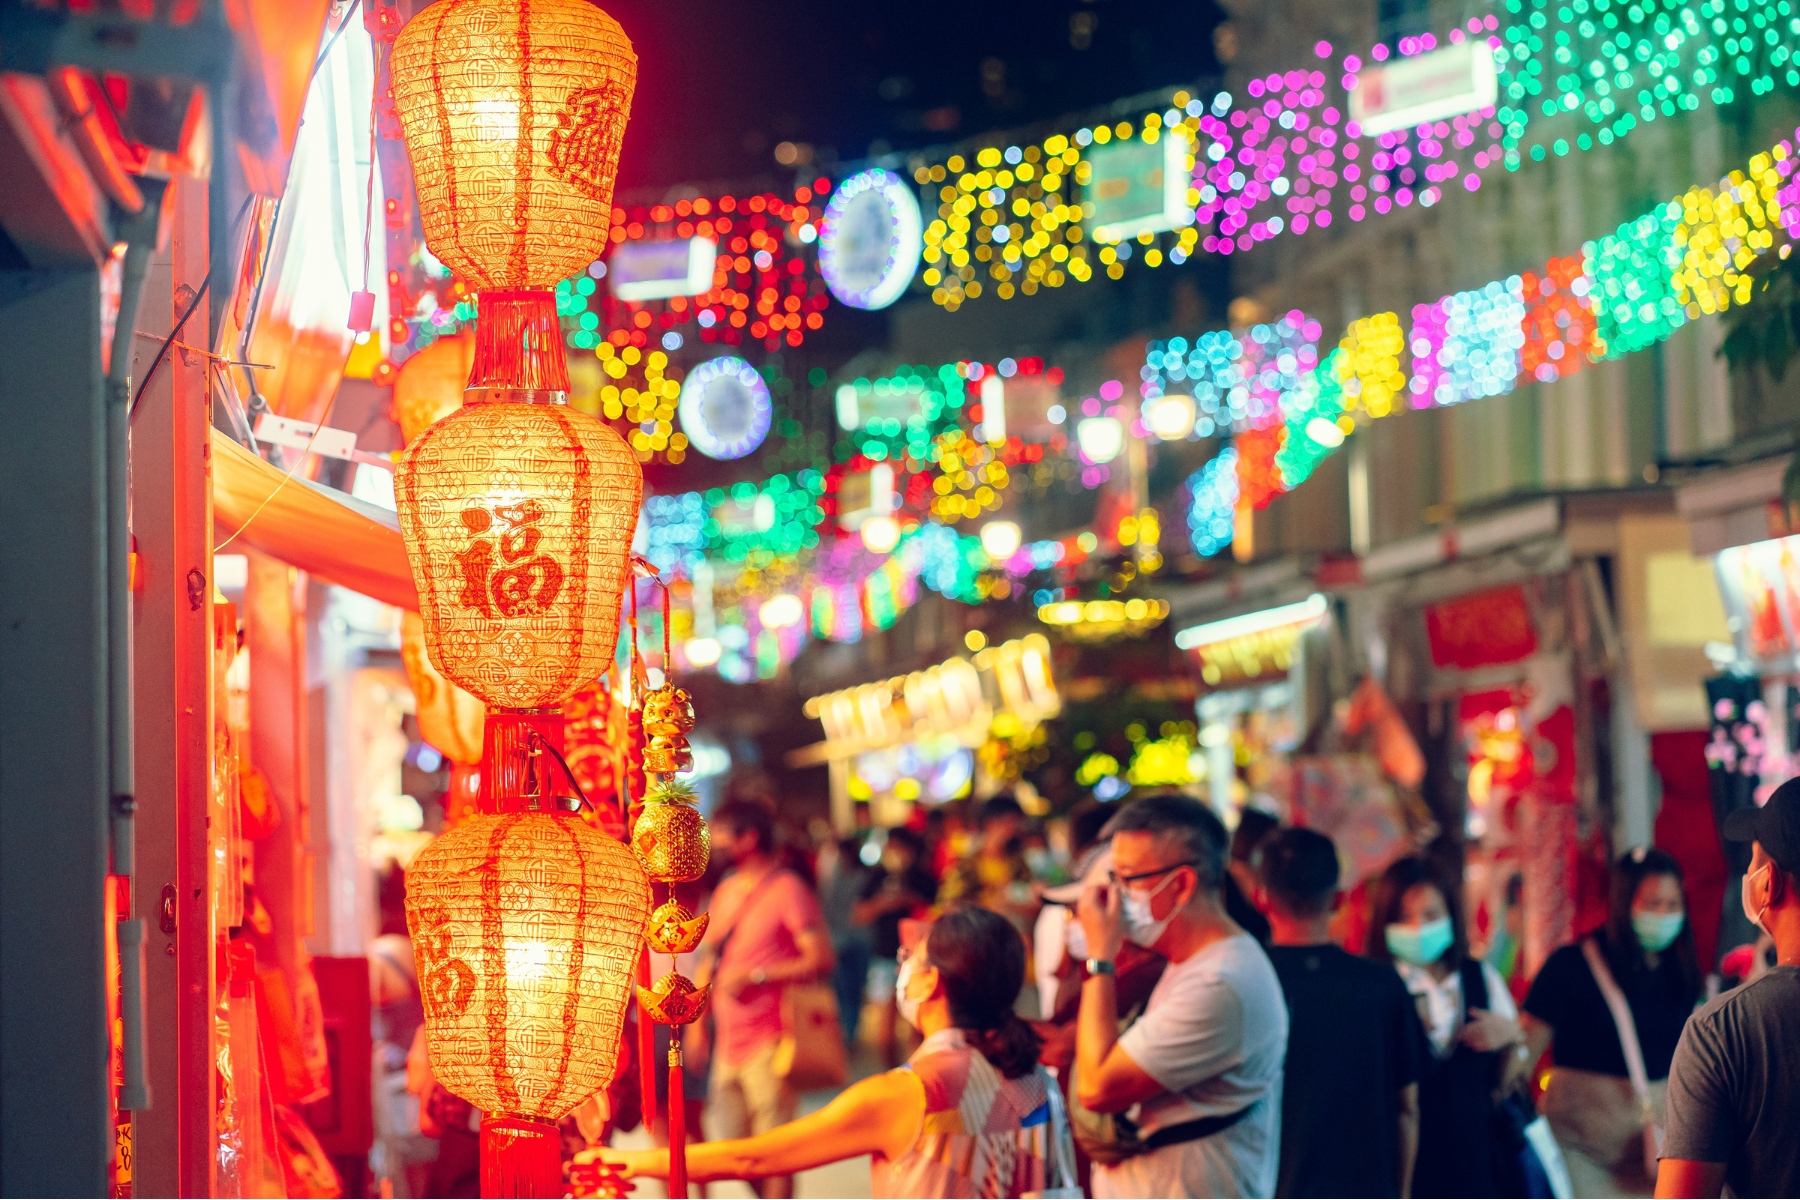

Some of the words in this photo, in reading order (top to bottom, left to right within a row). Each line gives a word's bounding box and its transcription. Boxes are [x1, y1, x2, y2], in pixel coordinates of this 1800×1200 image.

[468, 10, 498, 34] 福
[560, 26, 587, 53] 福
[466, 59, 497, 88] 福
[470, 114, 500, 145] 福
[472, 170, 503, 200] 福
[532, 183, 559, 213] 福
[475, 226, 506, 255] 福
[462, 446, 490, 472] 福
[518, 448, 550, 473] 福
[598, 479, 620, 508] 福
[421, 496, 441, 525] 福
[450, 499, 565, 620] 福
[478, 661, 508, 684] 福
[534, 660, 563, 684] 福
[530, 860, 560, 888] 福
[619, 893, 638, 922] 福
[526, 912, 557, 942] 福
[523, 970, 553, 999] 福
[520, 1024, 551, 1055] 福
[518, 1078, 549, 1098] 福
